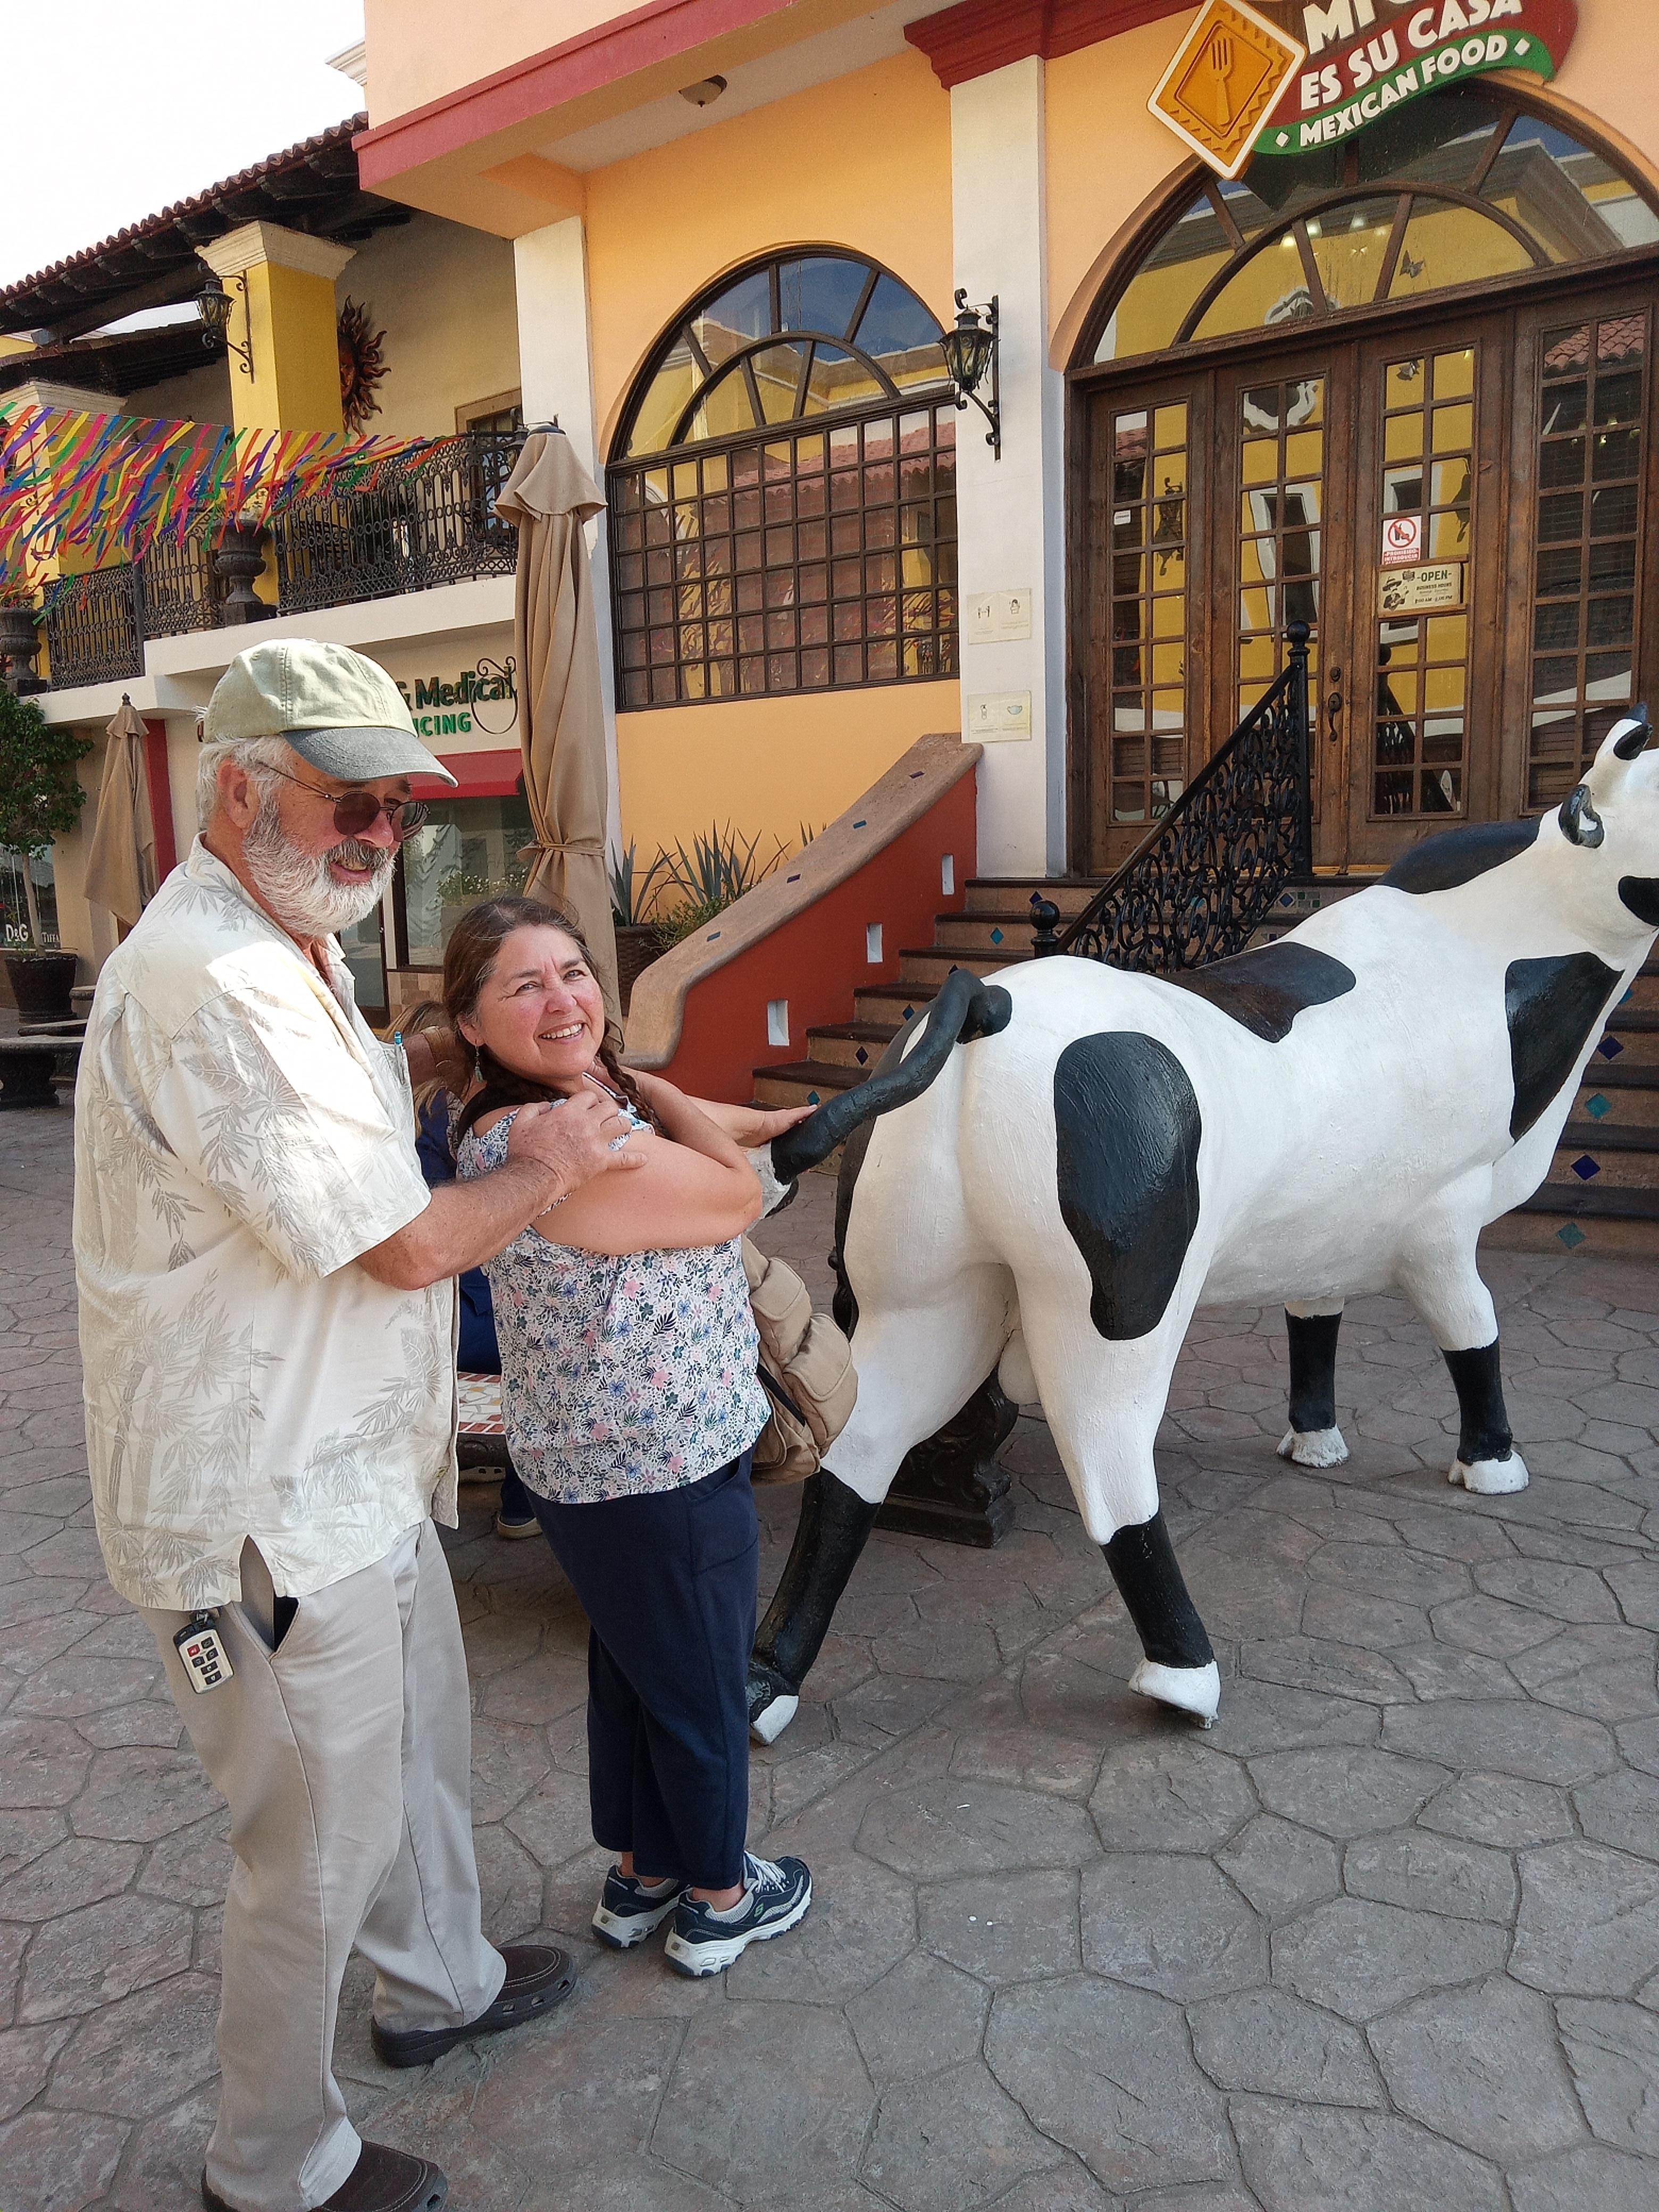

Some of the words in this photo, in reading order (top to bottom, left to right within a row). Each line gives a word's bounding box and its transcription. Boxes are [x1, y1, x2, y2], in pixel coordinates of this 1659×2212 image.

[1302, 0, 1376, 54] MI
[1301, 63, 1343, 111] ES
[1347, 29, 1399, 88] SU
[1407, 0, 1523, 48] CASA
[1299, 66, 1419, 147] MEXICAN
[1421, 35, 1508, 85] FOOD
[414, 666, 514, 709] Medical
[5, 924, 28, 942] D&G
